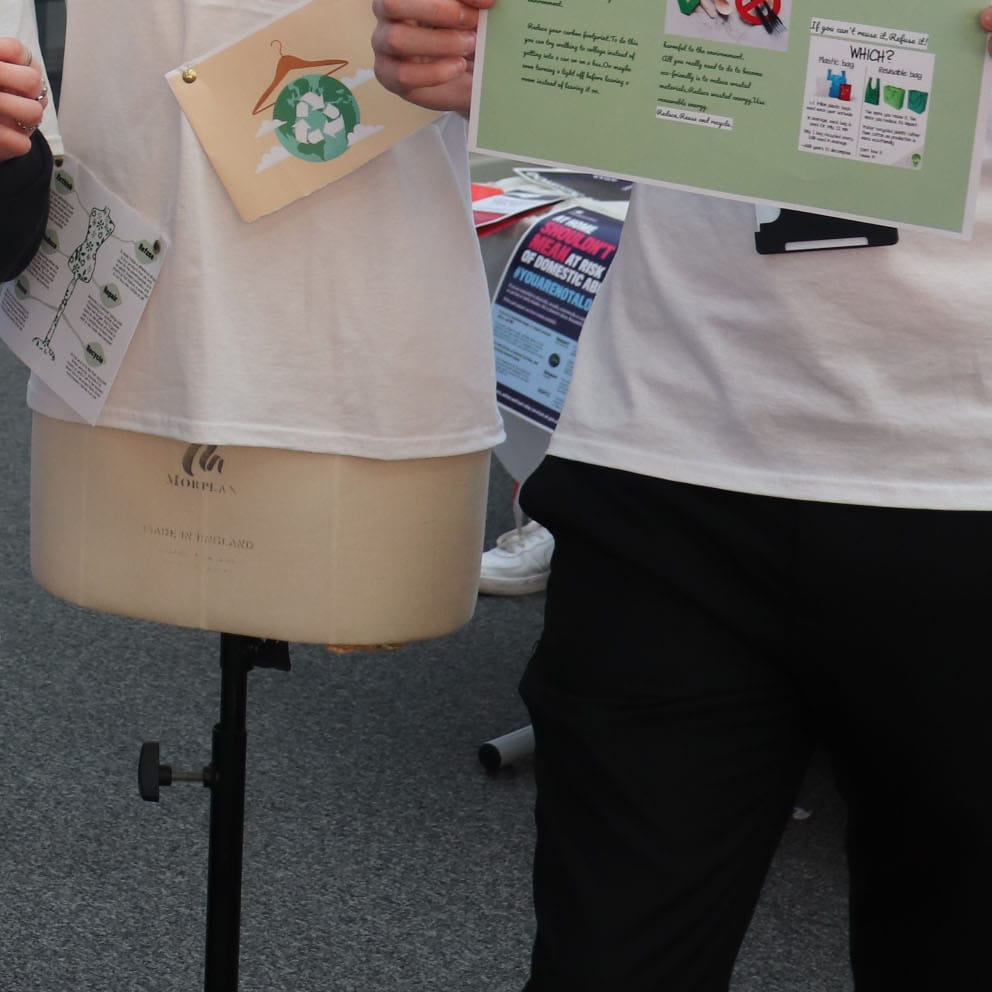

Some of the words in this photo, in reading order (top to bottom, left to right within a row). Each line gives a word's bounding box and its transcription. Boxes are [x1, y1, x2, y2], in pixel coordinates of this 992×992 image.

[822, 26, 834, 35] you
[850, 45, 895, 63] WHICH?
[528, 233, 571, 263] MEAN
[565, 253, 583, 268] AT
[578, 258, 606, 279] RISK
[540, 220, 617, 260] SHOULDN'T
[520, 249, 537, 264] OF
[534, 254, 585, 288] DOMESTIC
